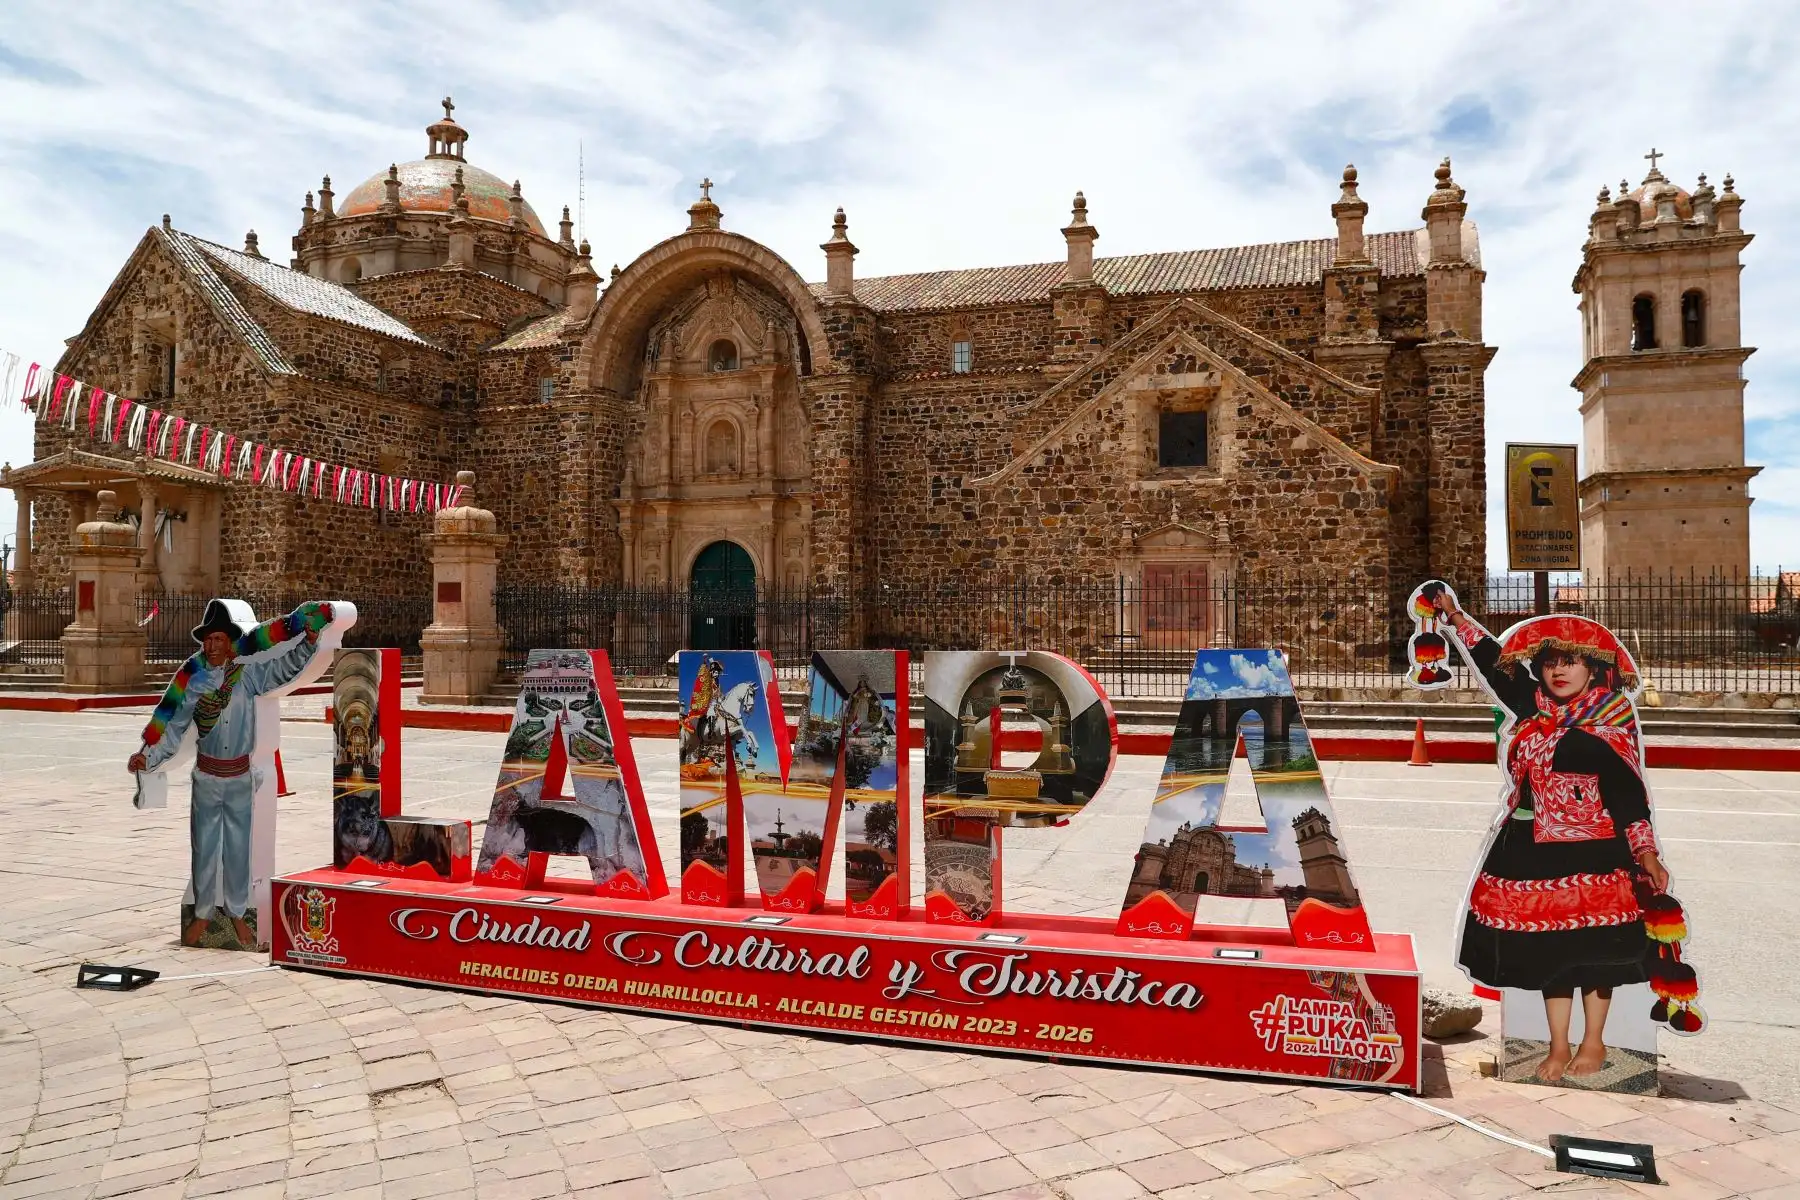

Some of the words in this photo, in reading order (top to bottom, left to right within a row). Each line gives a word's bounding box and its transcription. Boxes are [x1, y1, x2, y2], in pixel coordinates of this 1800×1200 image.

[1515, 530, 1573, 540] PROHIBIDO
[333, 648, 1376, 952] LAMPA
[389, 908, 591, 951] Ciudad
[604, 930, 870, 979] Cultural
[931, 949, 1204, 1009] Turística
[459, 961, 559, 985] HERACLIDES
[563, 973, 618, 993] OJEDA
[623, 980, 759, 1008] HUARILLOCLLA
[775, 997, 864, 1020] ALCALDE
[869, 1008, 960, 1030] GESTIÓN
[963, 1016, 1017, 1036] 2023
[1035, 1024, 1094, 1043] 2026
[1288, 999, 1356, 1017] LAMPA
[1288, 1016, 1369, 1042] PUKA
[1286, 1043, 1317, 1054] 2024
[1319, 1039, 1393, 1060] LLAQTA
